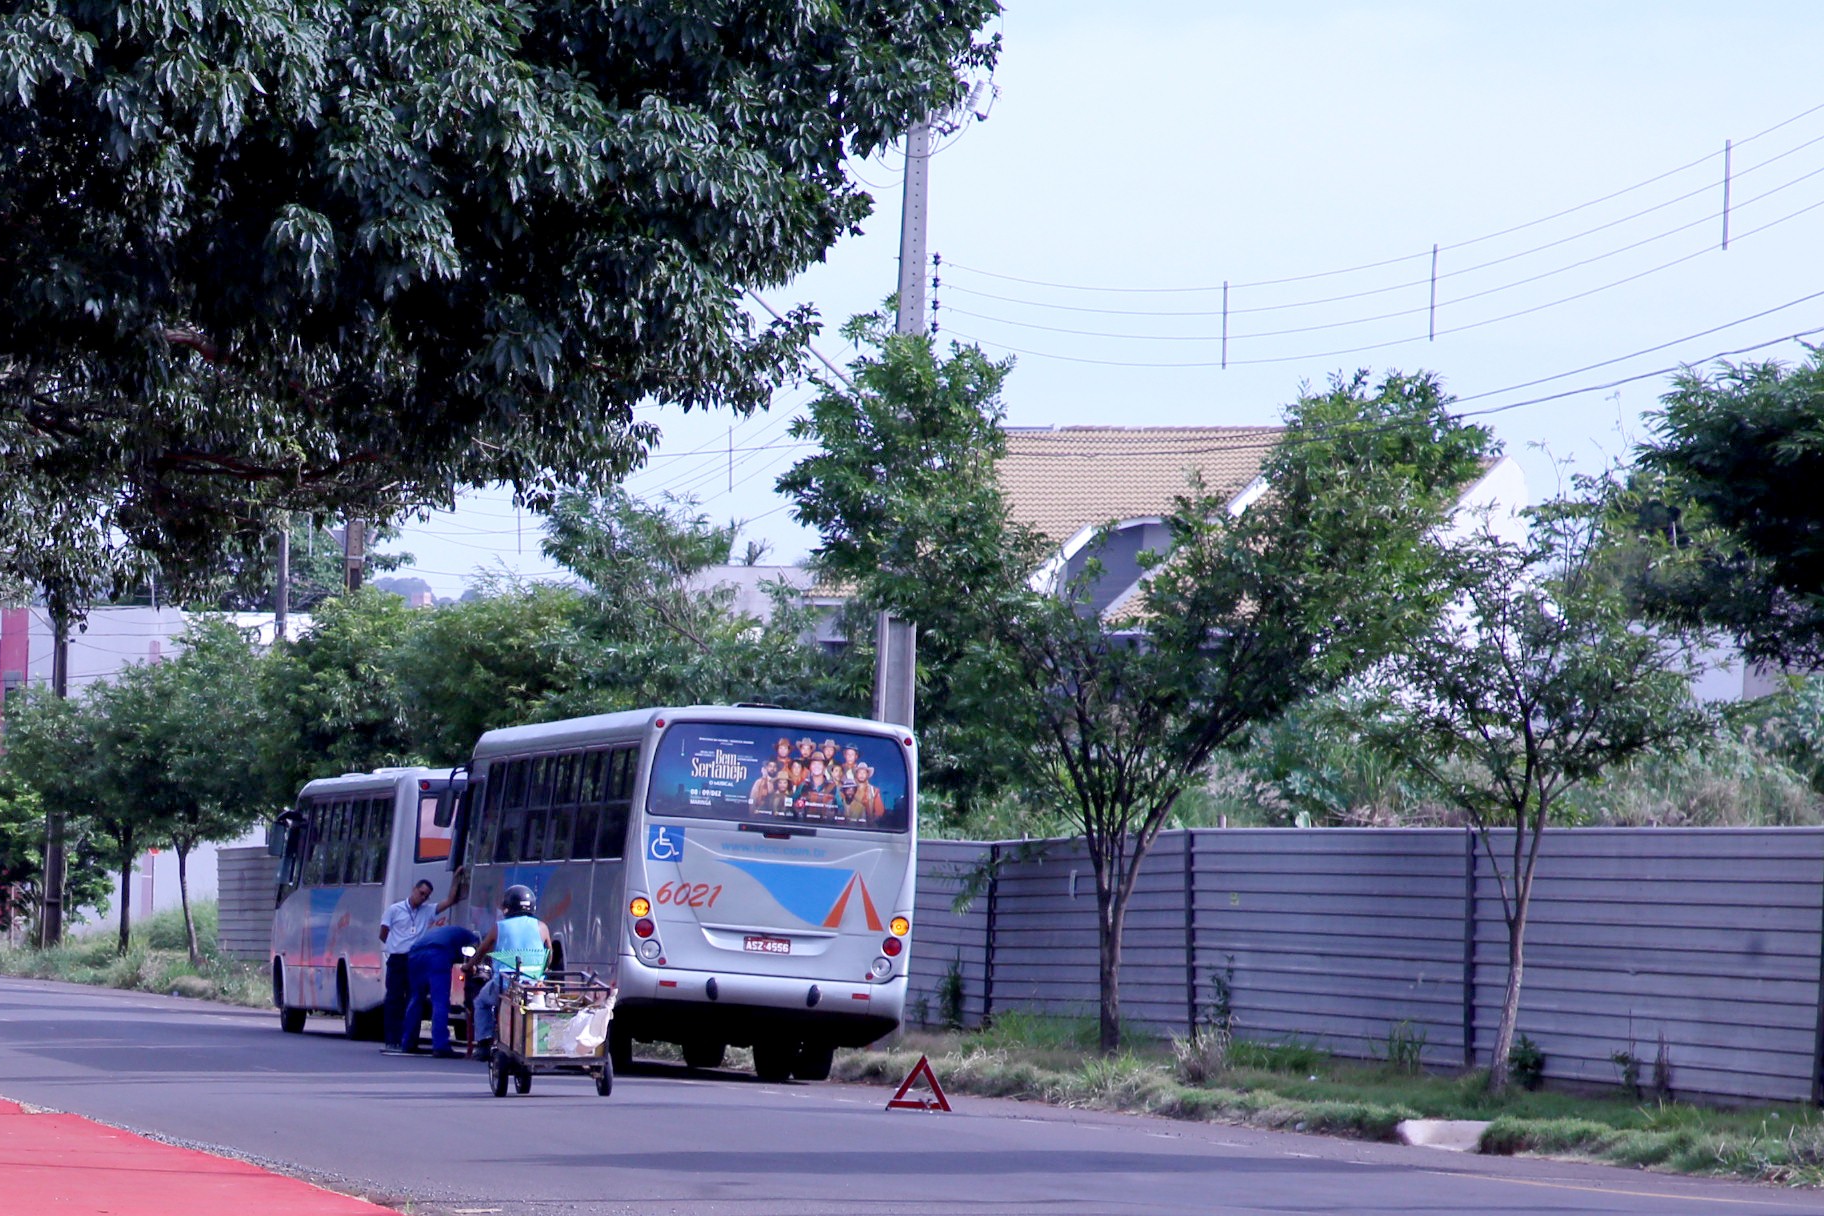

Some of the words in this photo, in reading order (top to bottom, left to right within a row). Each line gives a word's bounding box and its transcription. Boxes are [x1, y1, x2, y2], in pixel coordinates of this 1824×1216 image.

[691, 757, 747, 782] Sertanejo
[716, 749, 737, 765] Bem
[656, 881, 723, 908] 6021
